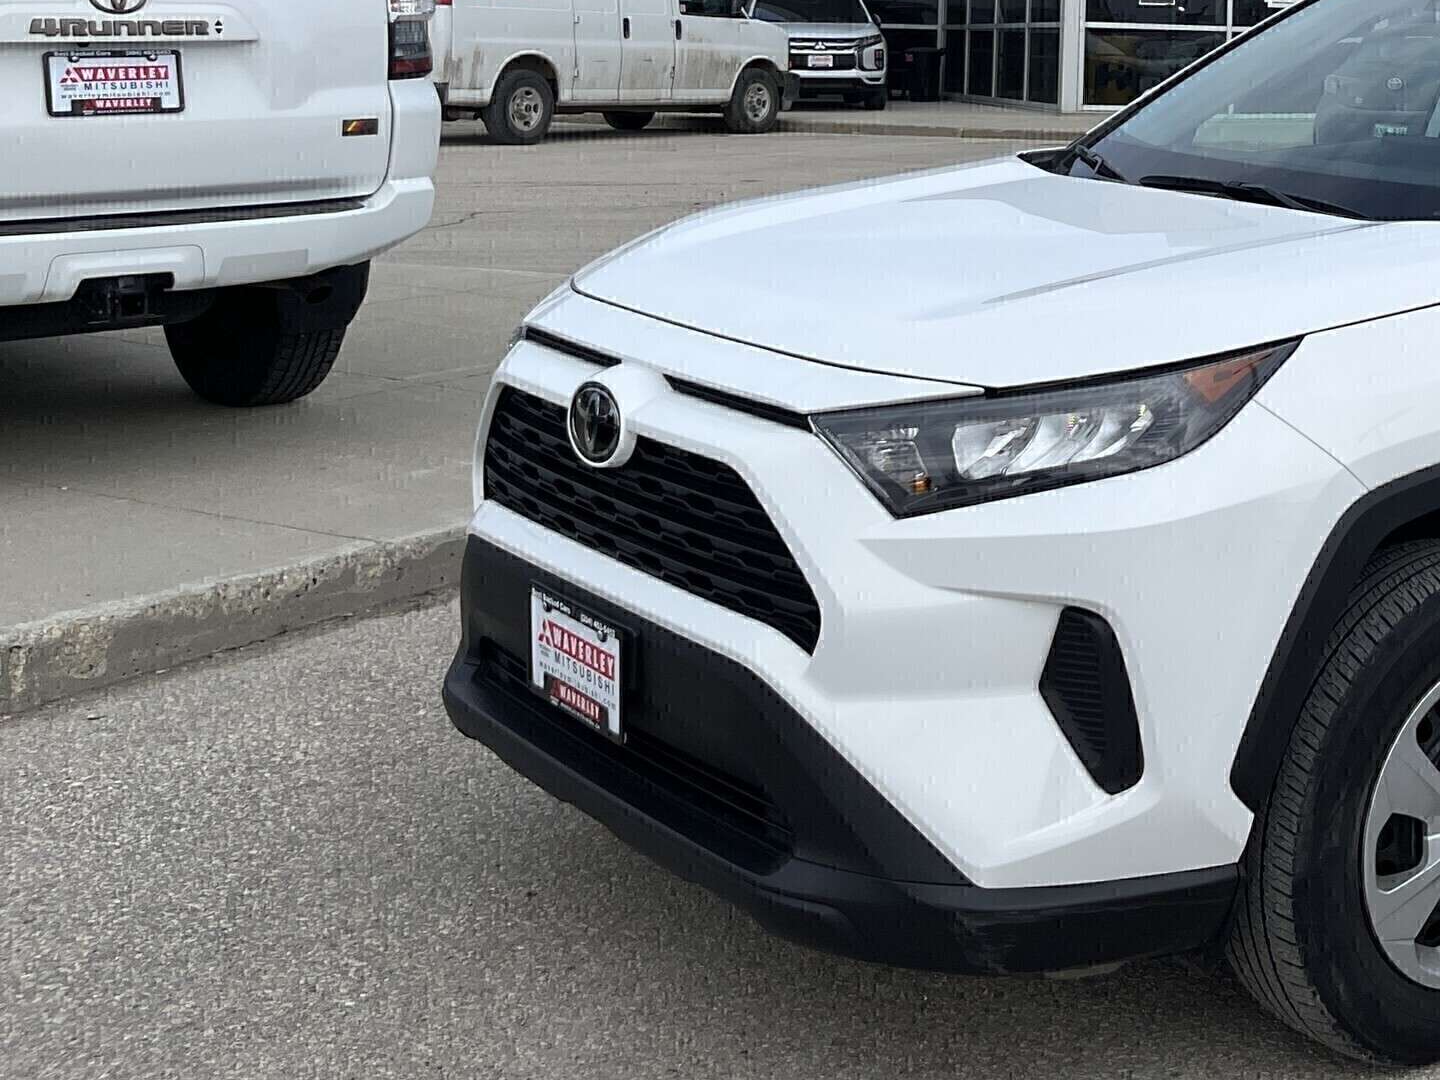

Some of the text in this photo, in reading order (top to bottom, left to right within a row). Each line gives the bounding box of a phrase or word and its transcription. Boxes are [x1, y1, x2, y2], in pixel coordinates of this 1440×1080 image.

[81, 66, 168, 82] WAVERLEY
[84, 80, 169, 91] MITSUBISHI
[95, 98, 152, 109] WAVERLEY
[552, 624, 615, 678] WAVERLEY
[554, 651, 616, 697] MITSUBISHI
[559, 681, 600, 720] WAVERLEY
